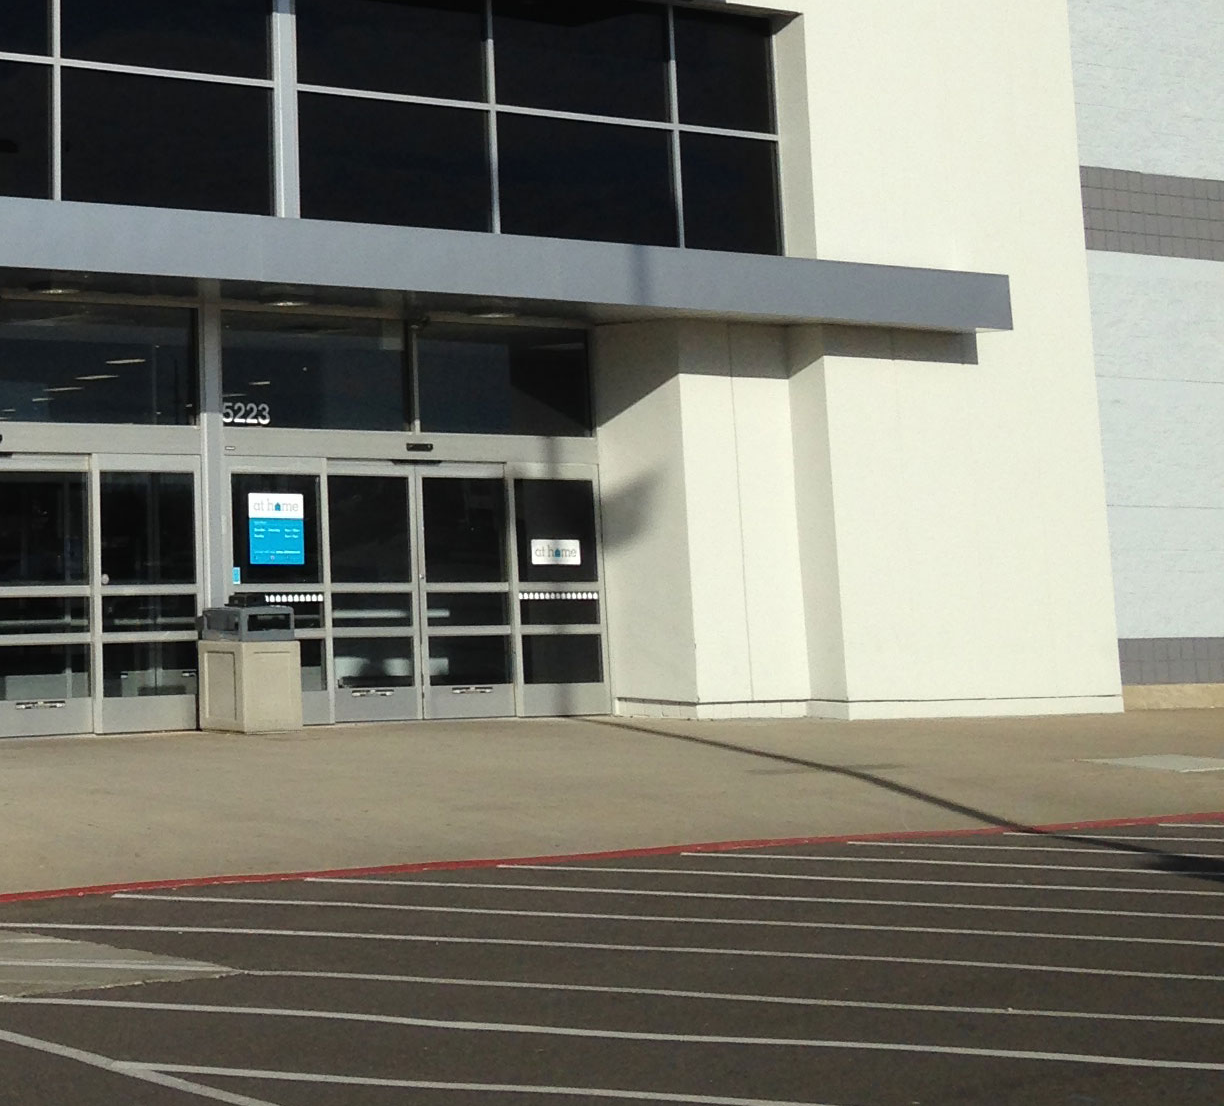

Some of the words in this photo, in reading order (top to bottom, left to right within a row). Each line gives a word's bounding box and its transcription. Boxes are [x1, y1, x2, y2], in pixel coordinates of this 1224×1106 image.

[222, 402, 271, 425] 5223
[253, 500, 265, 511] at
[535, 546, 546, 558] at
